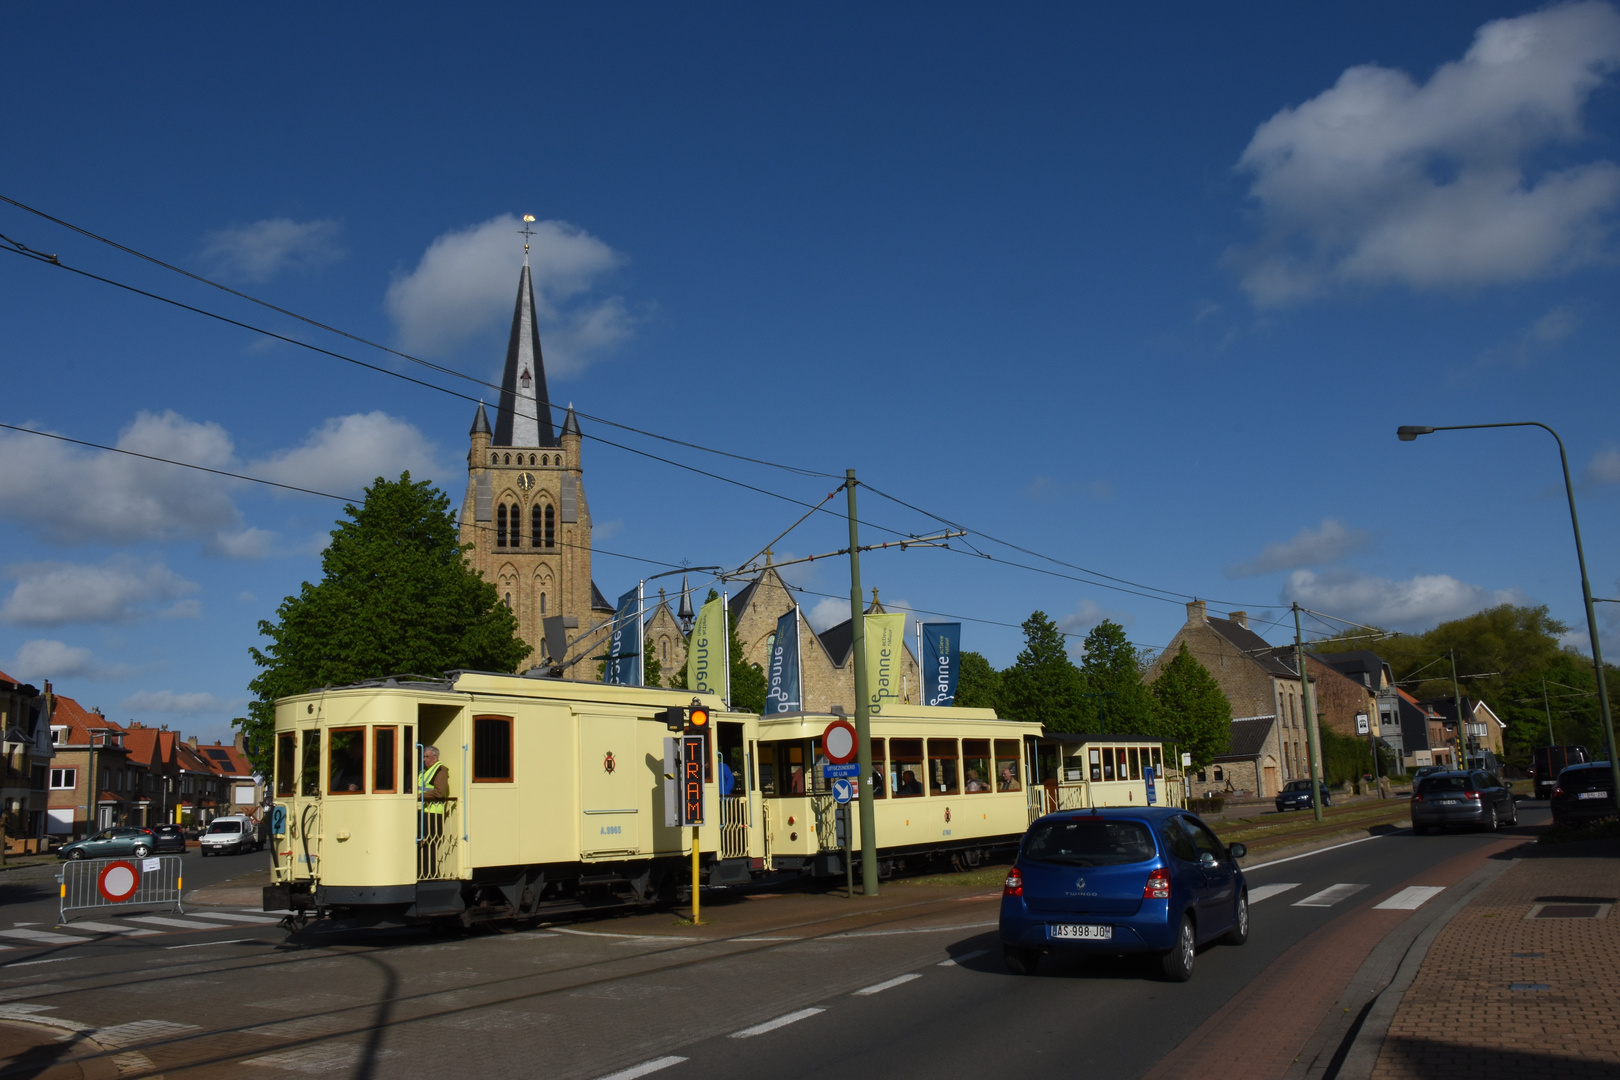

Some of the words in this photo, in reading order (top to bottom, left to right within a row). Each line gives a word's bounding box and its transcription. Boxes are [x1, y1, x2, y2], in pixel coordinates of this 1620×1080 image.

[867, 694, 882, 714] de
[877, 648, 899, 698] panne
[936, 656, 955, 701] panne
[686, 743, 700, 820] TRAM
[274, 809, 282, 830] 2
